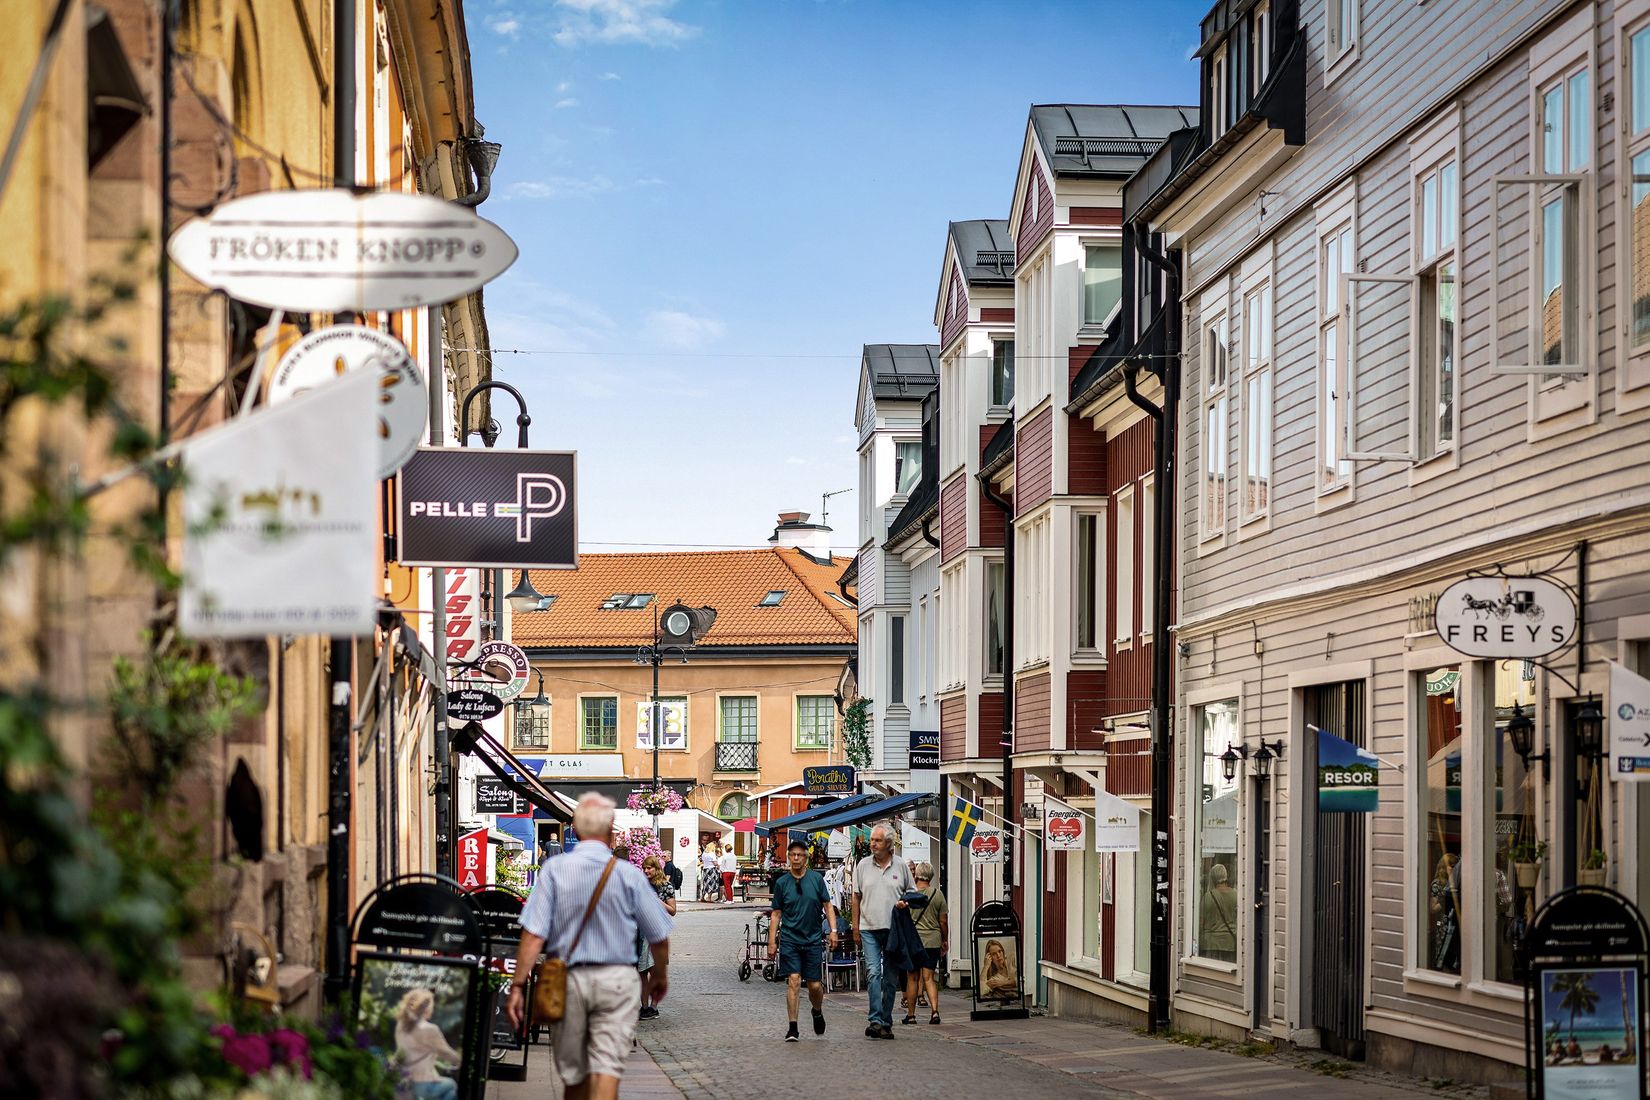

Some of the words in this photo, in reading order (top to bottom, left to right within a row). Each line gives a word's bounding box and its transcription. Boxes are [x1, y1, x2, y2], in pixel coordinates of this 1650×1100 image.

[209, 233, 338, 262] FRÖKEN
[356, 236, 465, 263] KNOPP
[410, 501, 487, 518] PELLE
[1447, 625, 1565, 643] FREYS
[447, 702, 465, 713] Lady
[464, 703, 473, 711] &
[1324, 772, 1373, 784] RESOR
[477, 785, 514, 800] Salong
[1048, 810, 1082, 820] Energizer
[974, 830, 1000, 838] nergizer
[461, 837, 481, 887] REA
